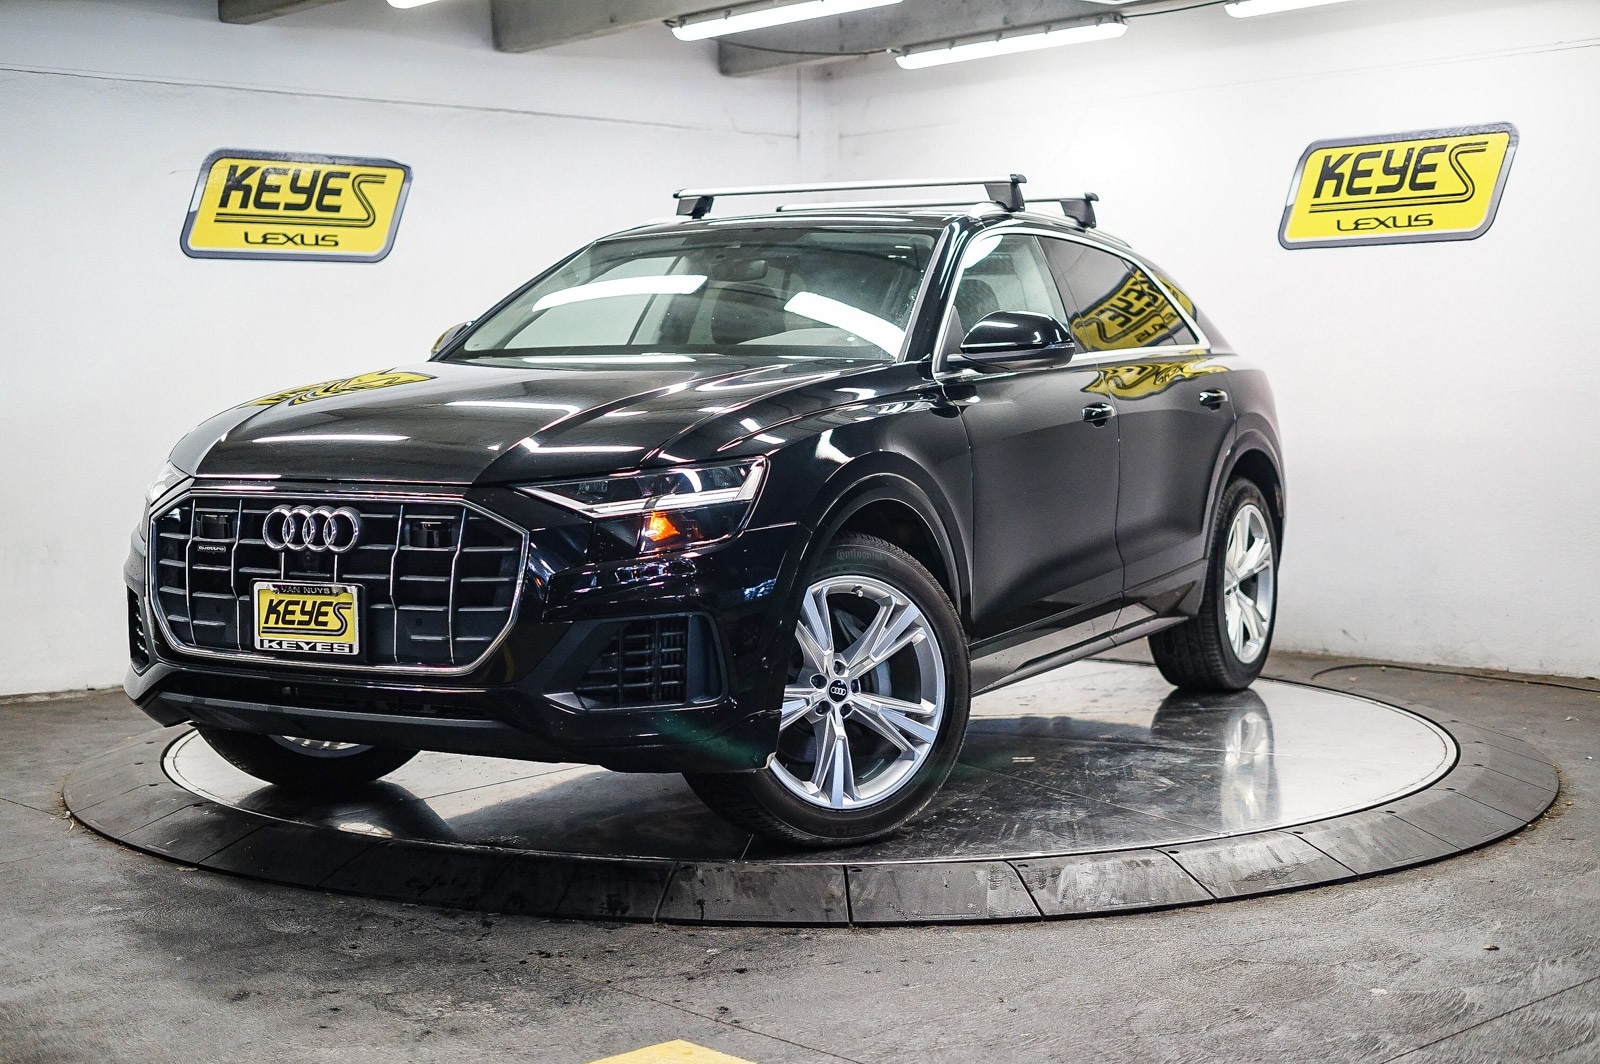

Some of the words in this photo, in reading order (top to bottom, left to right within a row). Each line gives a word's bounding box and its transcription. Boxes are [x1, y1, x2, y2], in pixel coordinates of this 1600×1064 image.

[1308, 141, 1489, 213] KEYES
[214, 164, 387, 228] KEYES
[1337, 213, 1434, 231] LEXUS
[244, 231, 339, 247] LEXUS
[281, 585, 300, 594] VAN
[303, 586, 331, 595] NUYS
[261, 598, 353, 637] KEYES
[263, 639, 350, 653] KEYES
